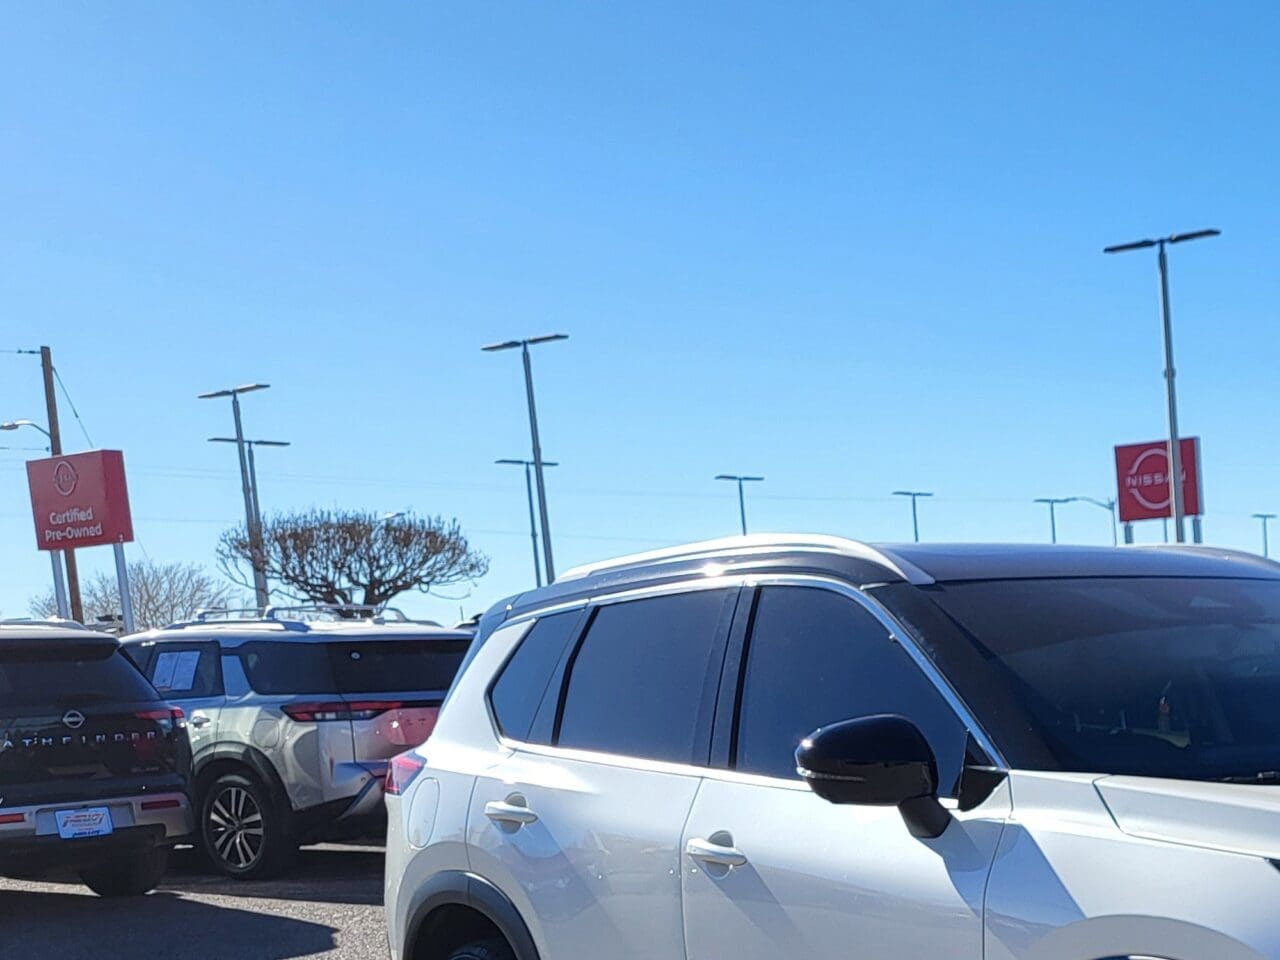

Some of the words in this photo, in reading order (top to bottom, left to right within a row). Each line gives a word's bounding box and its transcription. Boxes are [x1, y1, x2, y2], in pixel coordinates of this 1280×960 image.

[1125, 469, 1186, 488] NISS
[49, 506, 93, 525] Certified
[45, 522, 102, 541] Pre-Owned
[2, 731, 157, 748] ATHFINDER
